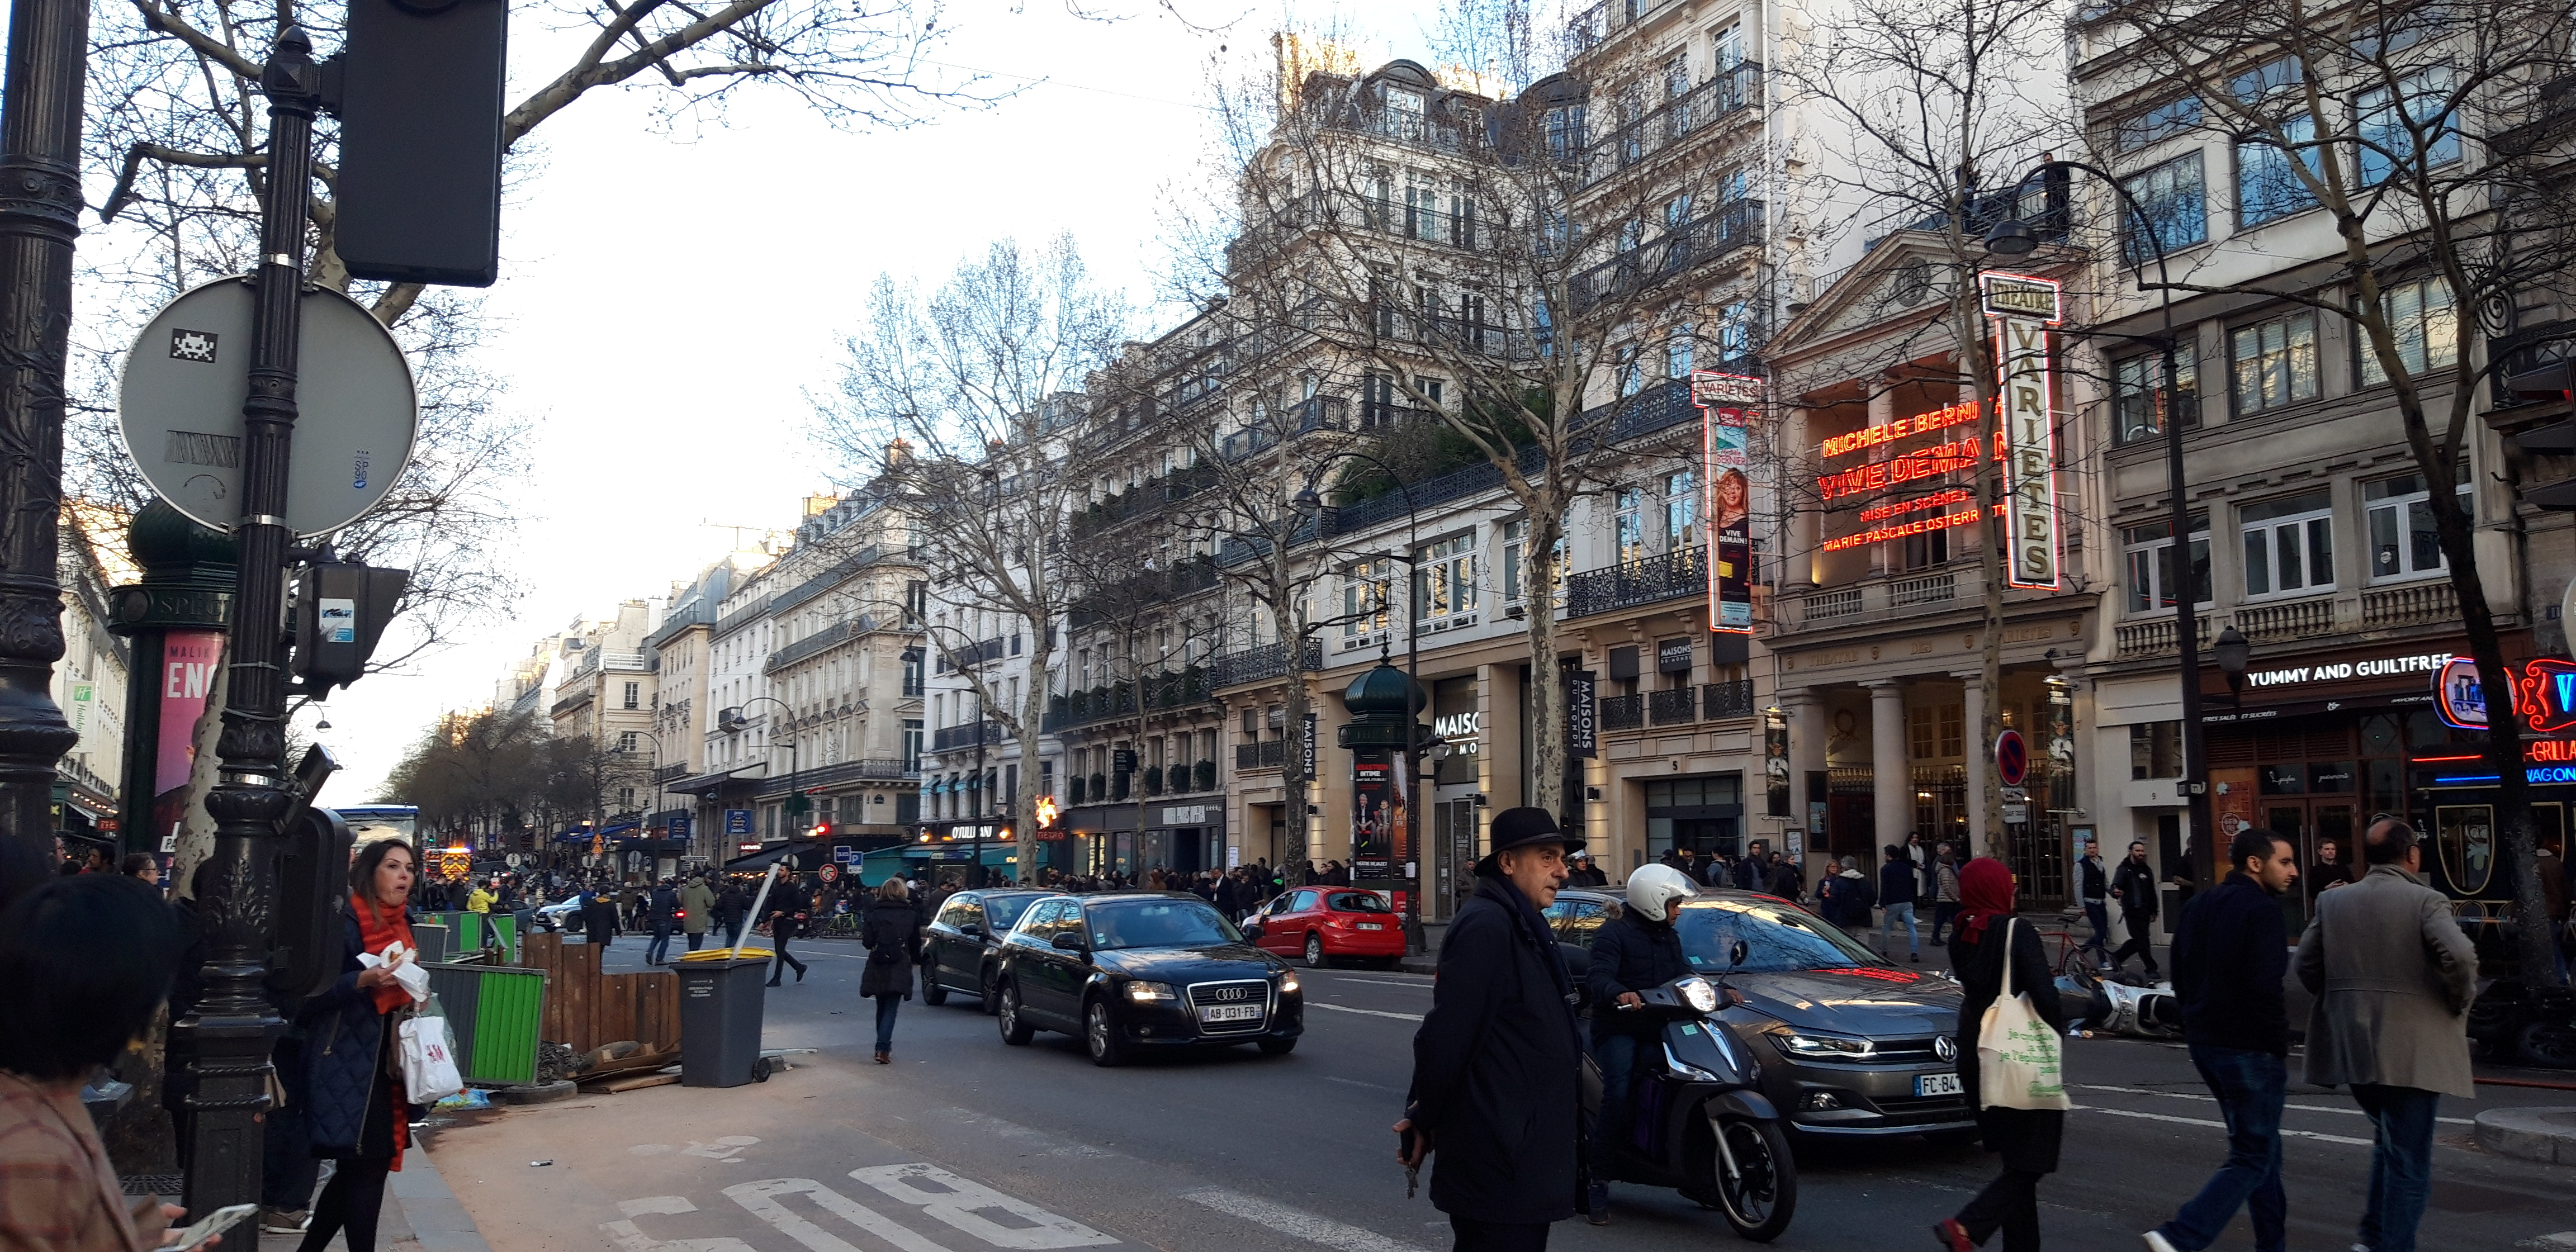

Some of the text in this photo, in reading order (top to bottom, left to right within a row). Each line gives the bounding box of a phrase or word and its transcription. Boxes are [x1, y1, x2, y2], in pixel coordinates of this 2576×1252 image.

[354, 461, 369, 470] SP
[1717, 455, 1746, 466] BERNIER
[1817, 431, 2006, 500] VIVE DEMAN
[1860, 507, 1891, 522] MISE
[1894, 501, 1911, 515] EN
[1725, 529, 1741, 538] VIVE
[1824, 534, 1863, 552] MARIE
[1865, 521, 1922, 543] PASCALE
[1660, 644, 1691, 657] MAISONS
[2247, 667, 2309, 687] YUMMY
[2313, 663, 2352, 681] AND
[1580, 680, 1592, 749] MAISONS
[1304, 720, 1313, 774] MAISONS
[1210, 1006, 1256, 1019] AB-031-FB
